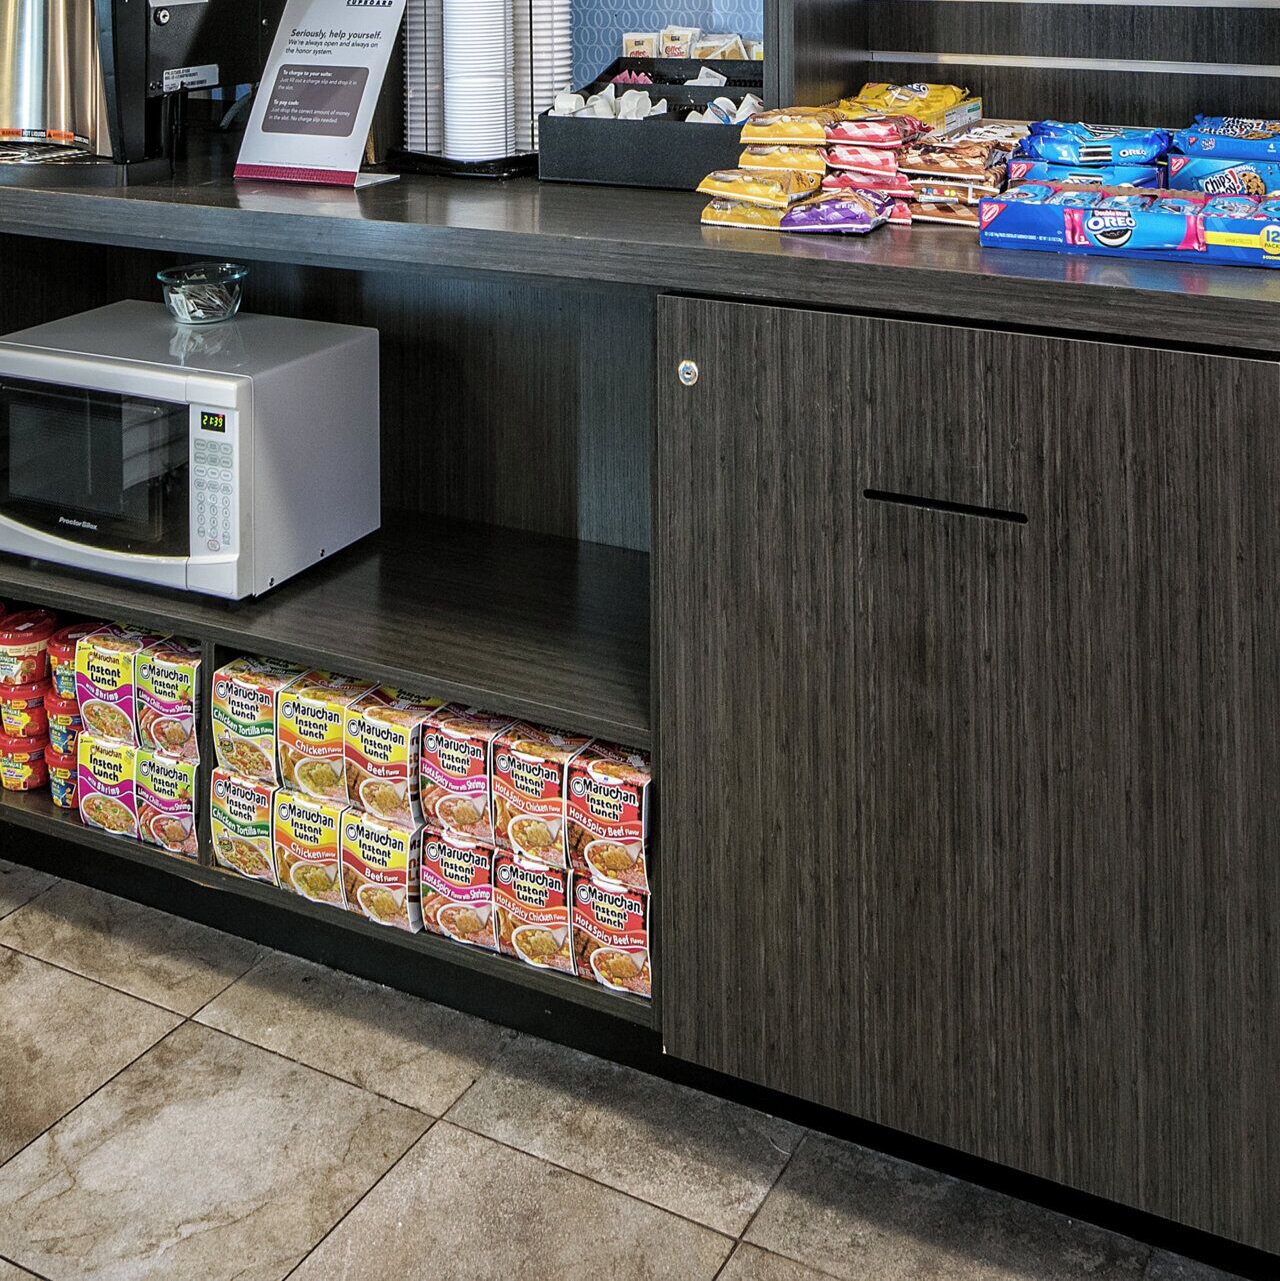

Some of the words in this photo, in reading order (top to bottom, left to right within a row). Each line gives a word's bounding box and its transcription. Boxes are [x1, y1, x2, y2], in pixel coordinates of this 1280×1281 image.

[291, 29, 327, 39] Seriously,
[329, 29, 345, 39] help
[349, 31, 382, 40] yourself.
[351, 41, 369, 49] always
[1087, 216, 1137, 230] OREO
[1264, 229, 1280, 243] 12
[88, 661, 120, 678] Instant
[148, 664, 189, 684] Maruchan
[91, 672, 117, 687] Lunch
[226, 682, 271, 706] Maruchan
[228, 698, 259, 713] Instant
[231, 706, 256, 721] Lunch
